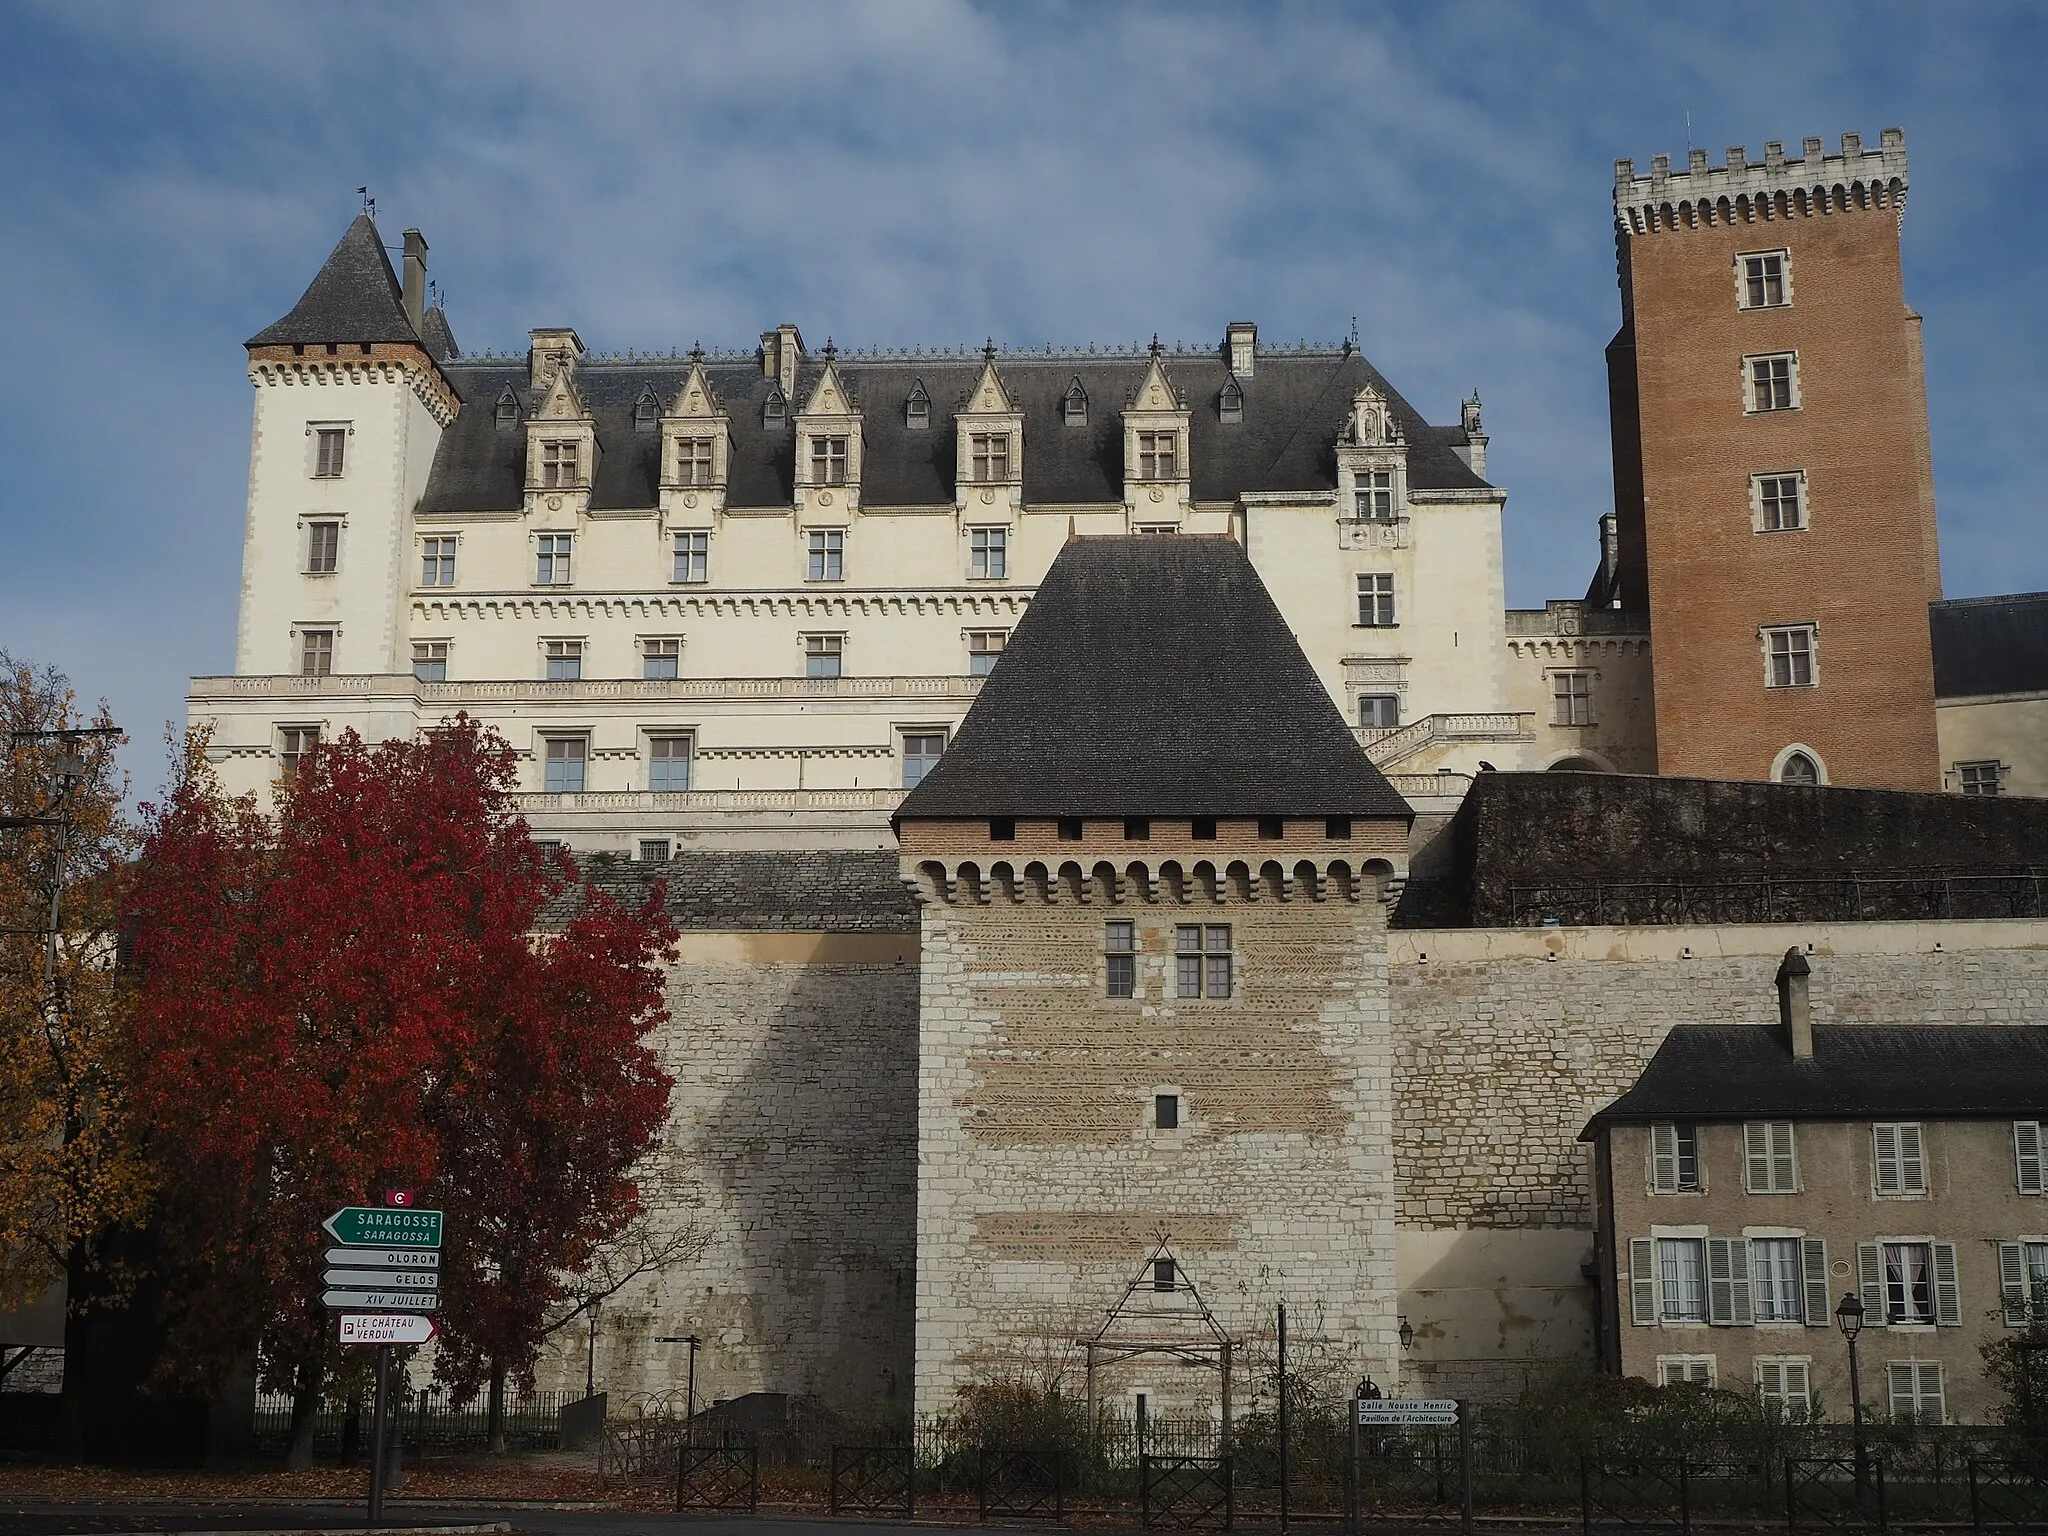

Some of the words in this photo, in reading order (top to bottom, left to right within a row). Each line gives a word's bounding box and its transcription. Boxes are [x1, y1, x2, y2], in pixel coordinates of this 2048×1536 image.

[357, 1213, 437, 1228] SARAGOSSE
[364, 1230, 430, 1241] SARAGOSSA
[388, 1254, 436, 1265] OLORON
[396, 1275, 435, 1284] GELOS
[365, 1295, 385, 1305] XIV
[390, 1295, 435, 1306] JUILLET
[357, 1318, 368, 1327] LE
[372, 1316, 414, 1328] CHÂTEAU
[357, 1329, 395, 1339] VERDUN
